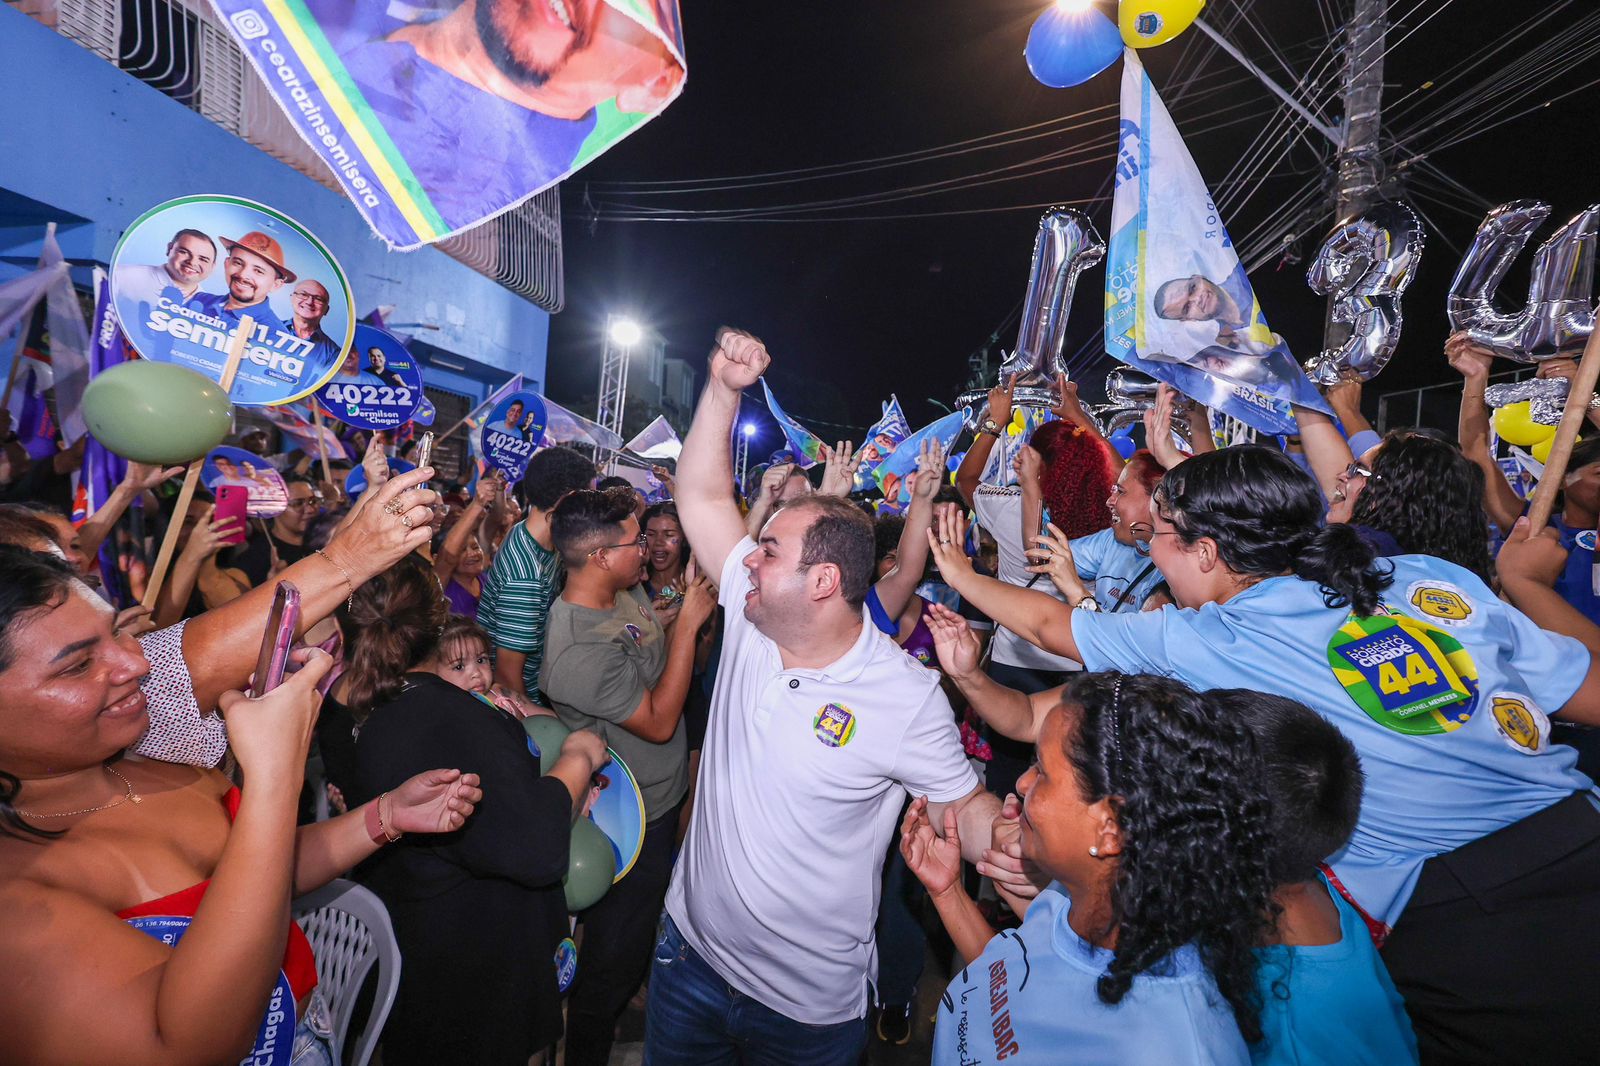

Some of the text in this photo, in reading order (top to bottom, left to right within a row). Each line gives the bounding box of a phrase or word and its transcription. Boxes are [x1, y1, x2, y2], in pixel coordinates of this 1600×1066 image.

[261, 38, 380, 209] cearazinsemisera
[158, 297, 227, 330] Cearazin
[326, 384, 412, 406] 40222
[1232, 384, 1277, 413] BRASIL
[346, 403, 399, 418] Dermilson
[370, 416, 400, 425] Chagas
[486, 431, 531, 457] 40222
[1350, 638, 1405, 661] ROBERTO
[1378, 654, 1438, 695] 44
[1399, 703, 1429, 716] CORONEL
[820, 717, 843, 736] 44
[989, 959, 1009, 1017] IGREJA
[253, 986, 286, 1066] Chagas
[992, 1009, 1020, 1061] IBAC
